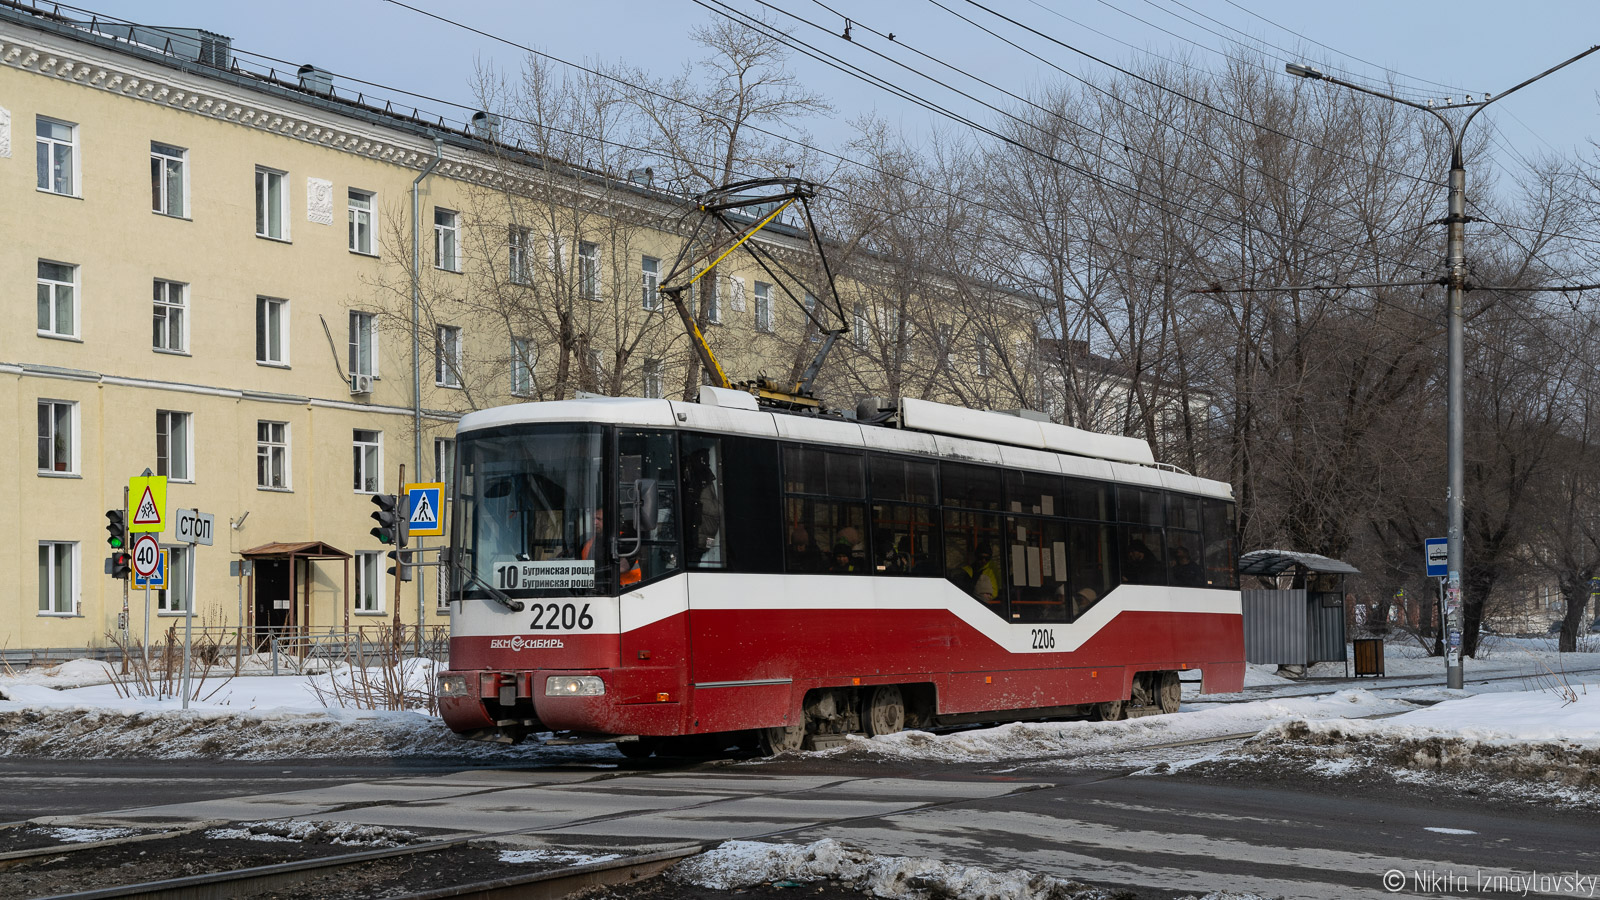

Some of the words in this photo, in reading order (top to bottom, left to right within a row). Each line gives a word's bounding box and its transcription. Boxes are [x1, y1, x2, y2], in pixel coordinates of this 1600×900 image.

[180, 516, 211, 539] СТОП
[137, 546, 154, 565] 40
[497, 565, 519, 589] 10
[522, 566, 569, 576] Бугринская
[571, 567, 595, 576] роща
[522, 579, 569, 588] Бугринская
[530, 603, 594, 630] 2206
[490, 639, 511, 649] БКМ
[524, 639, 564, 649] СИБИРЬ
[1032, 629, 1055, 649] 2206
